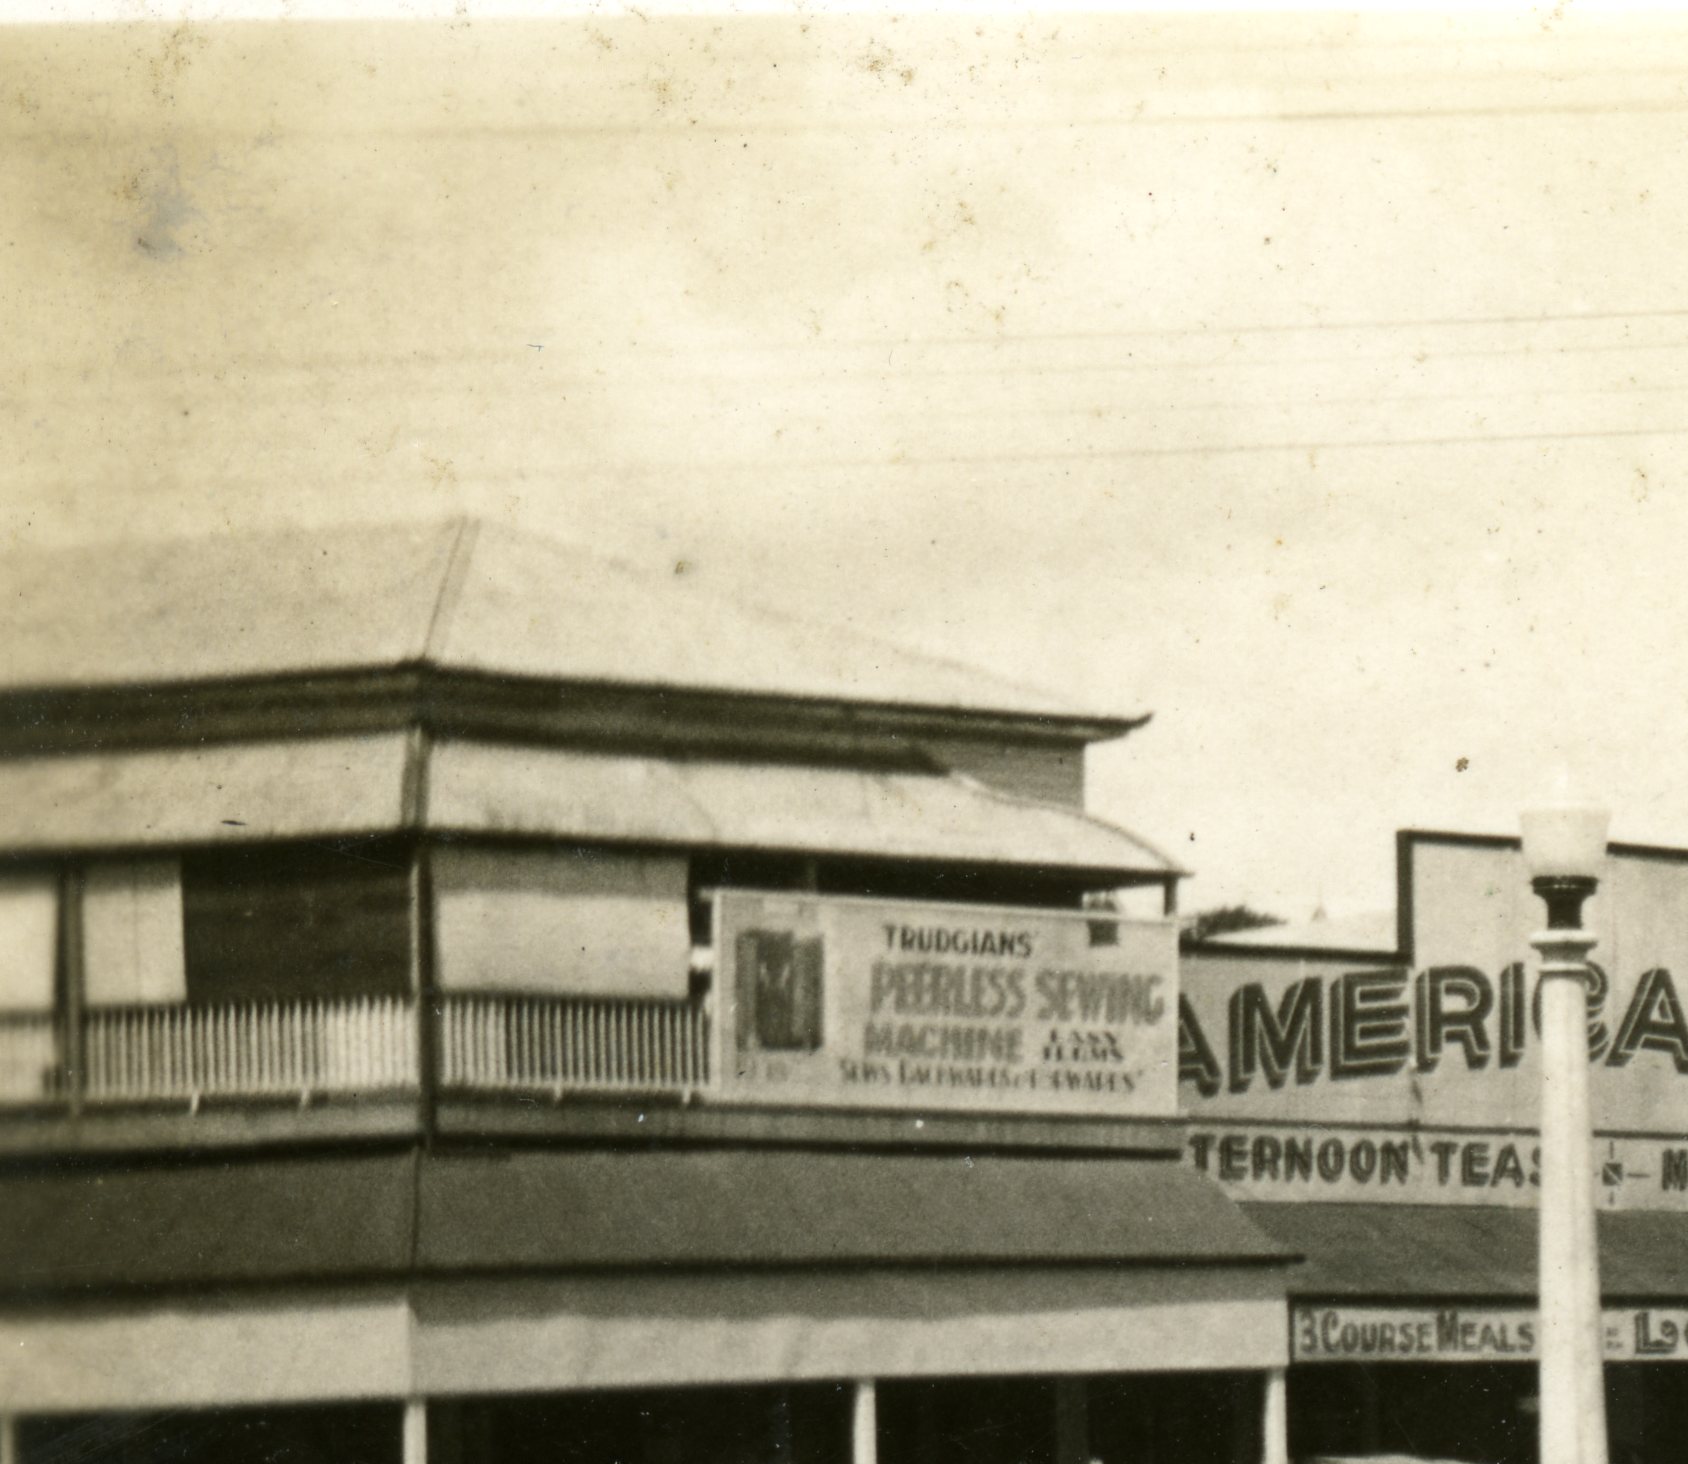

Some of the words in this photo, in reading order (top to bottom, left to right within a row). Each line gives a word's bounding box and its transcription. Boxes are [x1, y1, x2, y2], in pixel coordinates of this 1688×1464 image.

[869, 960, 1027, 1018] PEERLESS
[1034, 967, 1166, 1026] SEWING
[862, 1018, 1025, 1063] MACHINE
[1321, 1310, 1434, 1353] COURSE
[1435, 1309, 1536, 1353] MEALS
